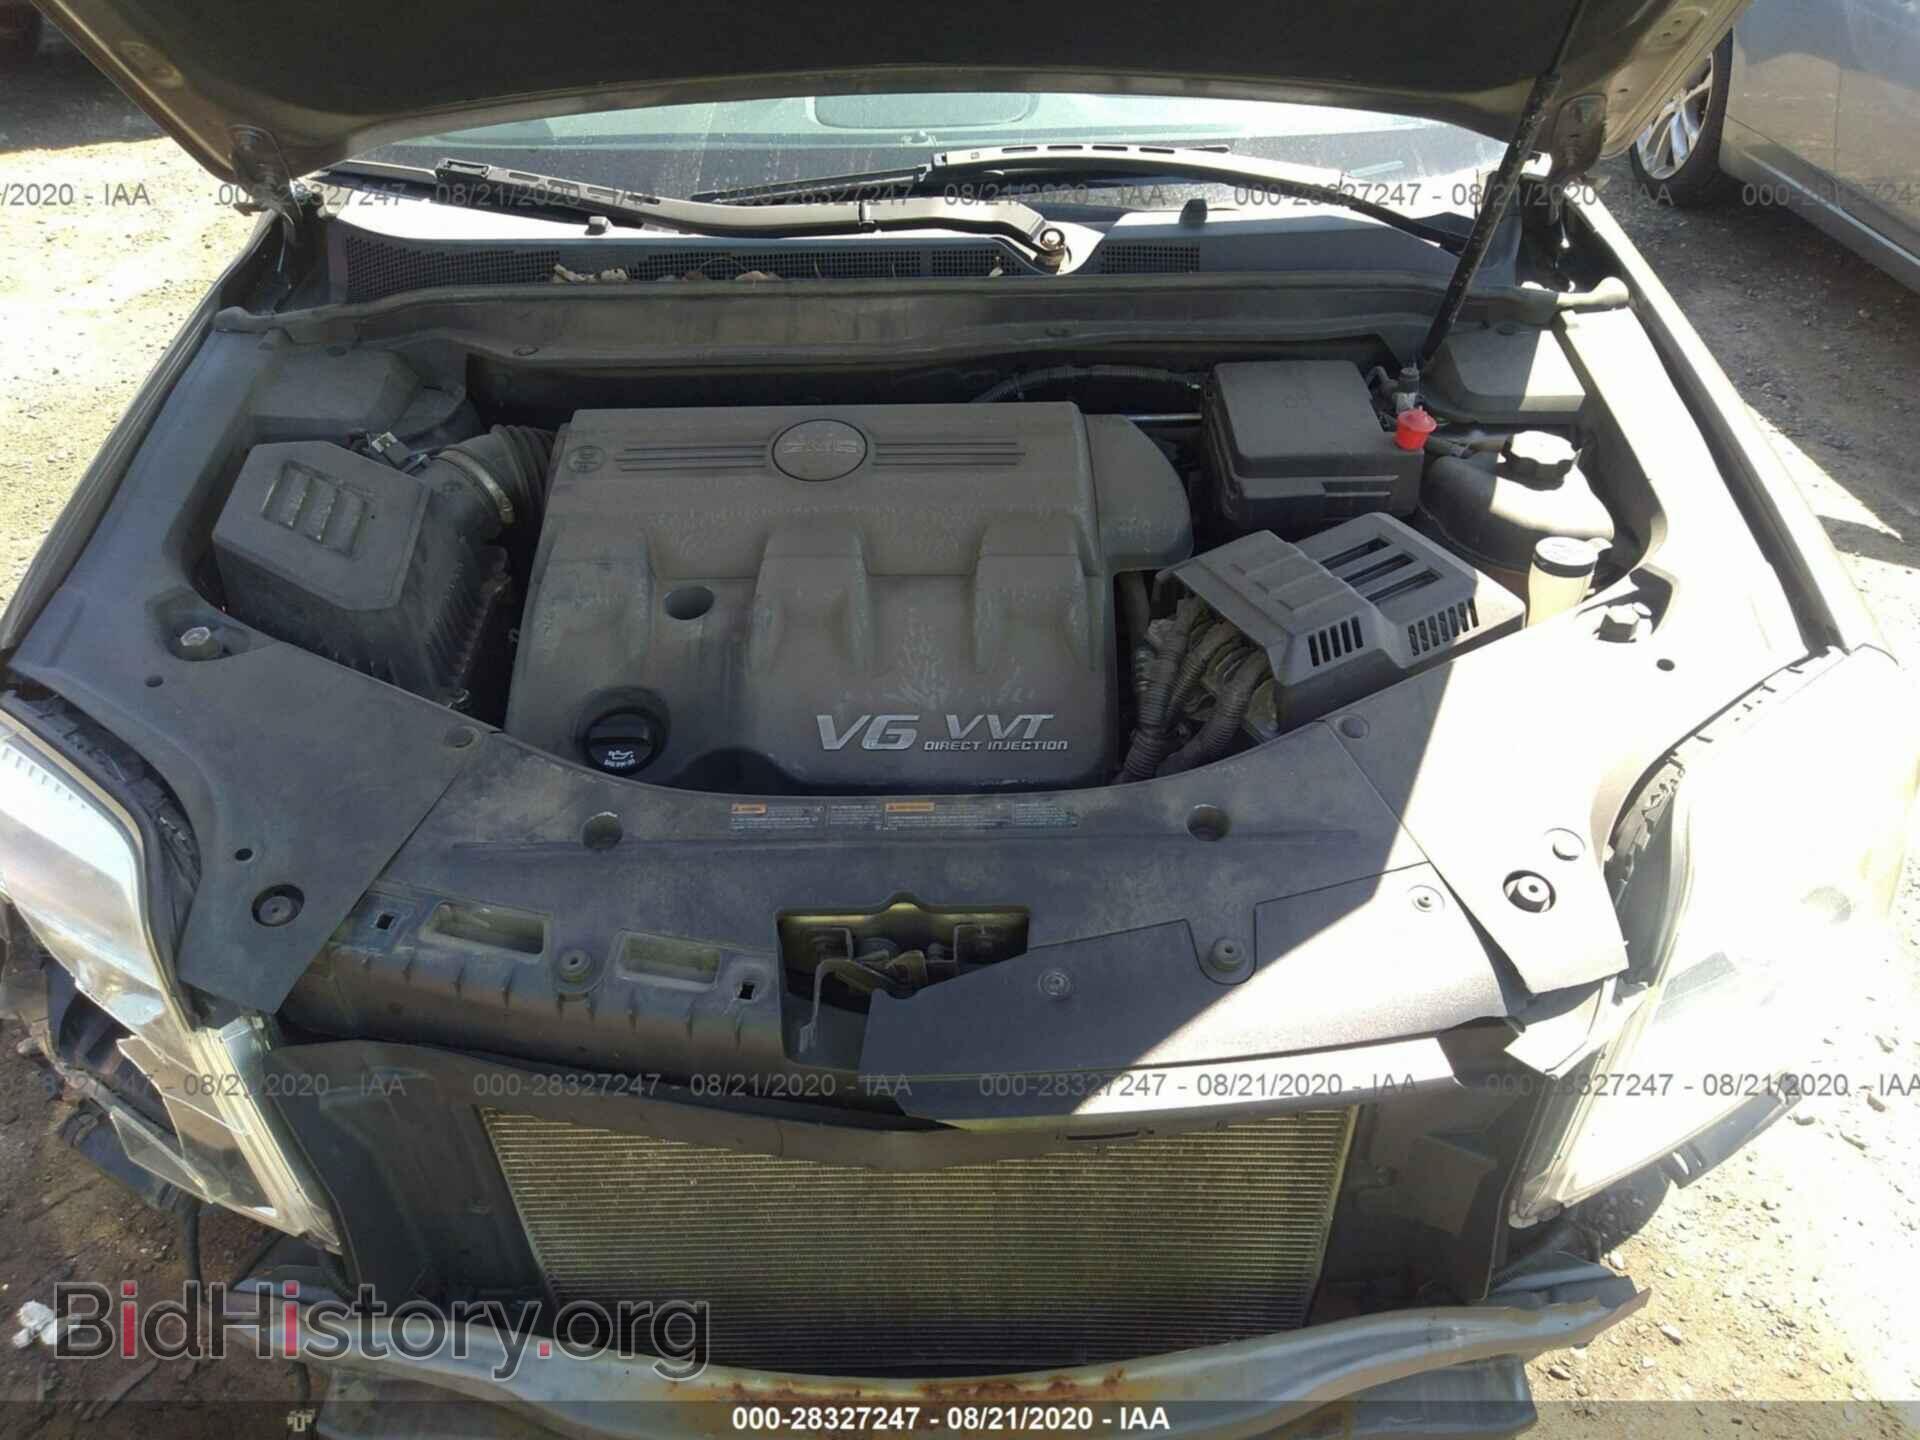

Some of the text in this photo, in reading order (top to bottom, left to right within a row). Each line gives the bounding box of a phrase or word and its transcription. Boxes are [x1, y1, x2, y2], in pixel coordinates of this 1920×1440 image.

[816, 714, 1054, 750] V6 VVT
[924, 740, 1069, 751] DIRECT INJECTION
